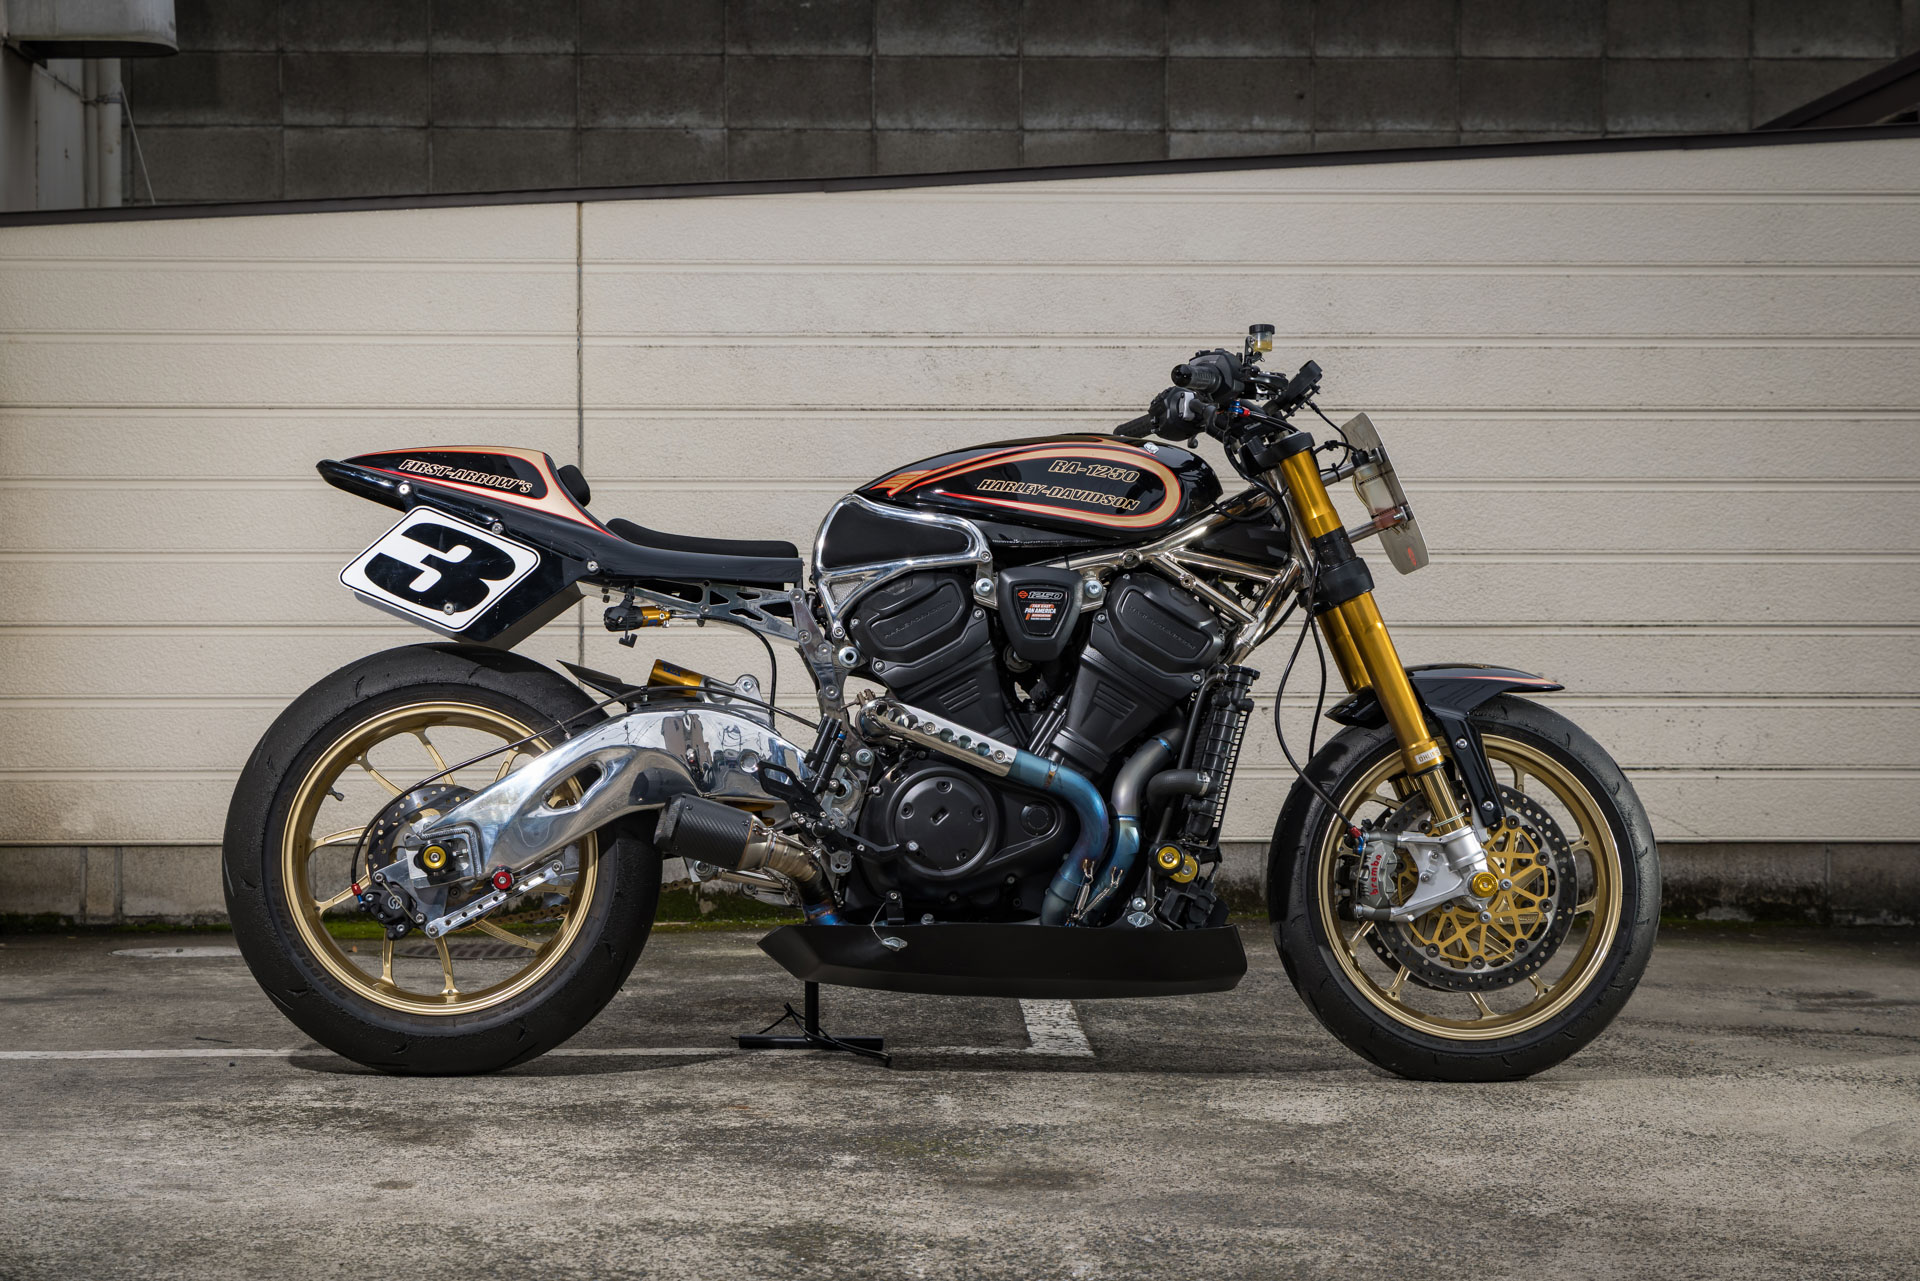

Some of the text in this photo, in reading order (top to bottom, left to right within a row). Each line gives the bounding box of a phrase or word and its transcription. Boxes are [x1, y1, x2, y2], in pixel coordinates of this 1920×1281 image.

[1048, 459, 1140, 483] RA-1250
[977, 479, 1140, 511] HARLEY-DAVIDSON
[364, 522, 516, 613] 3
[1028, 591, 1063, 600] 1250
[1370, 855, 1382, 895] brembo
